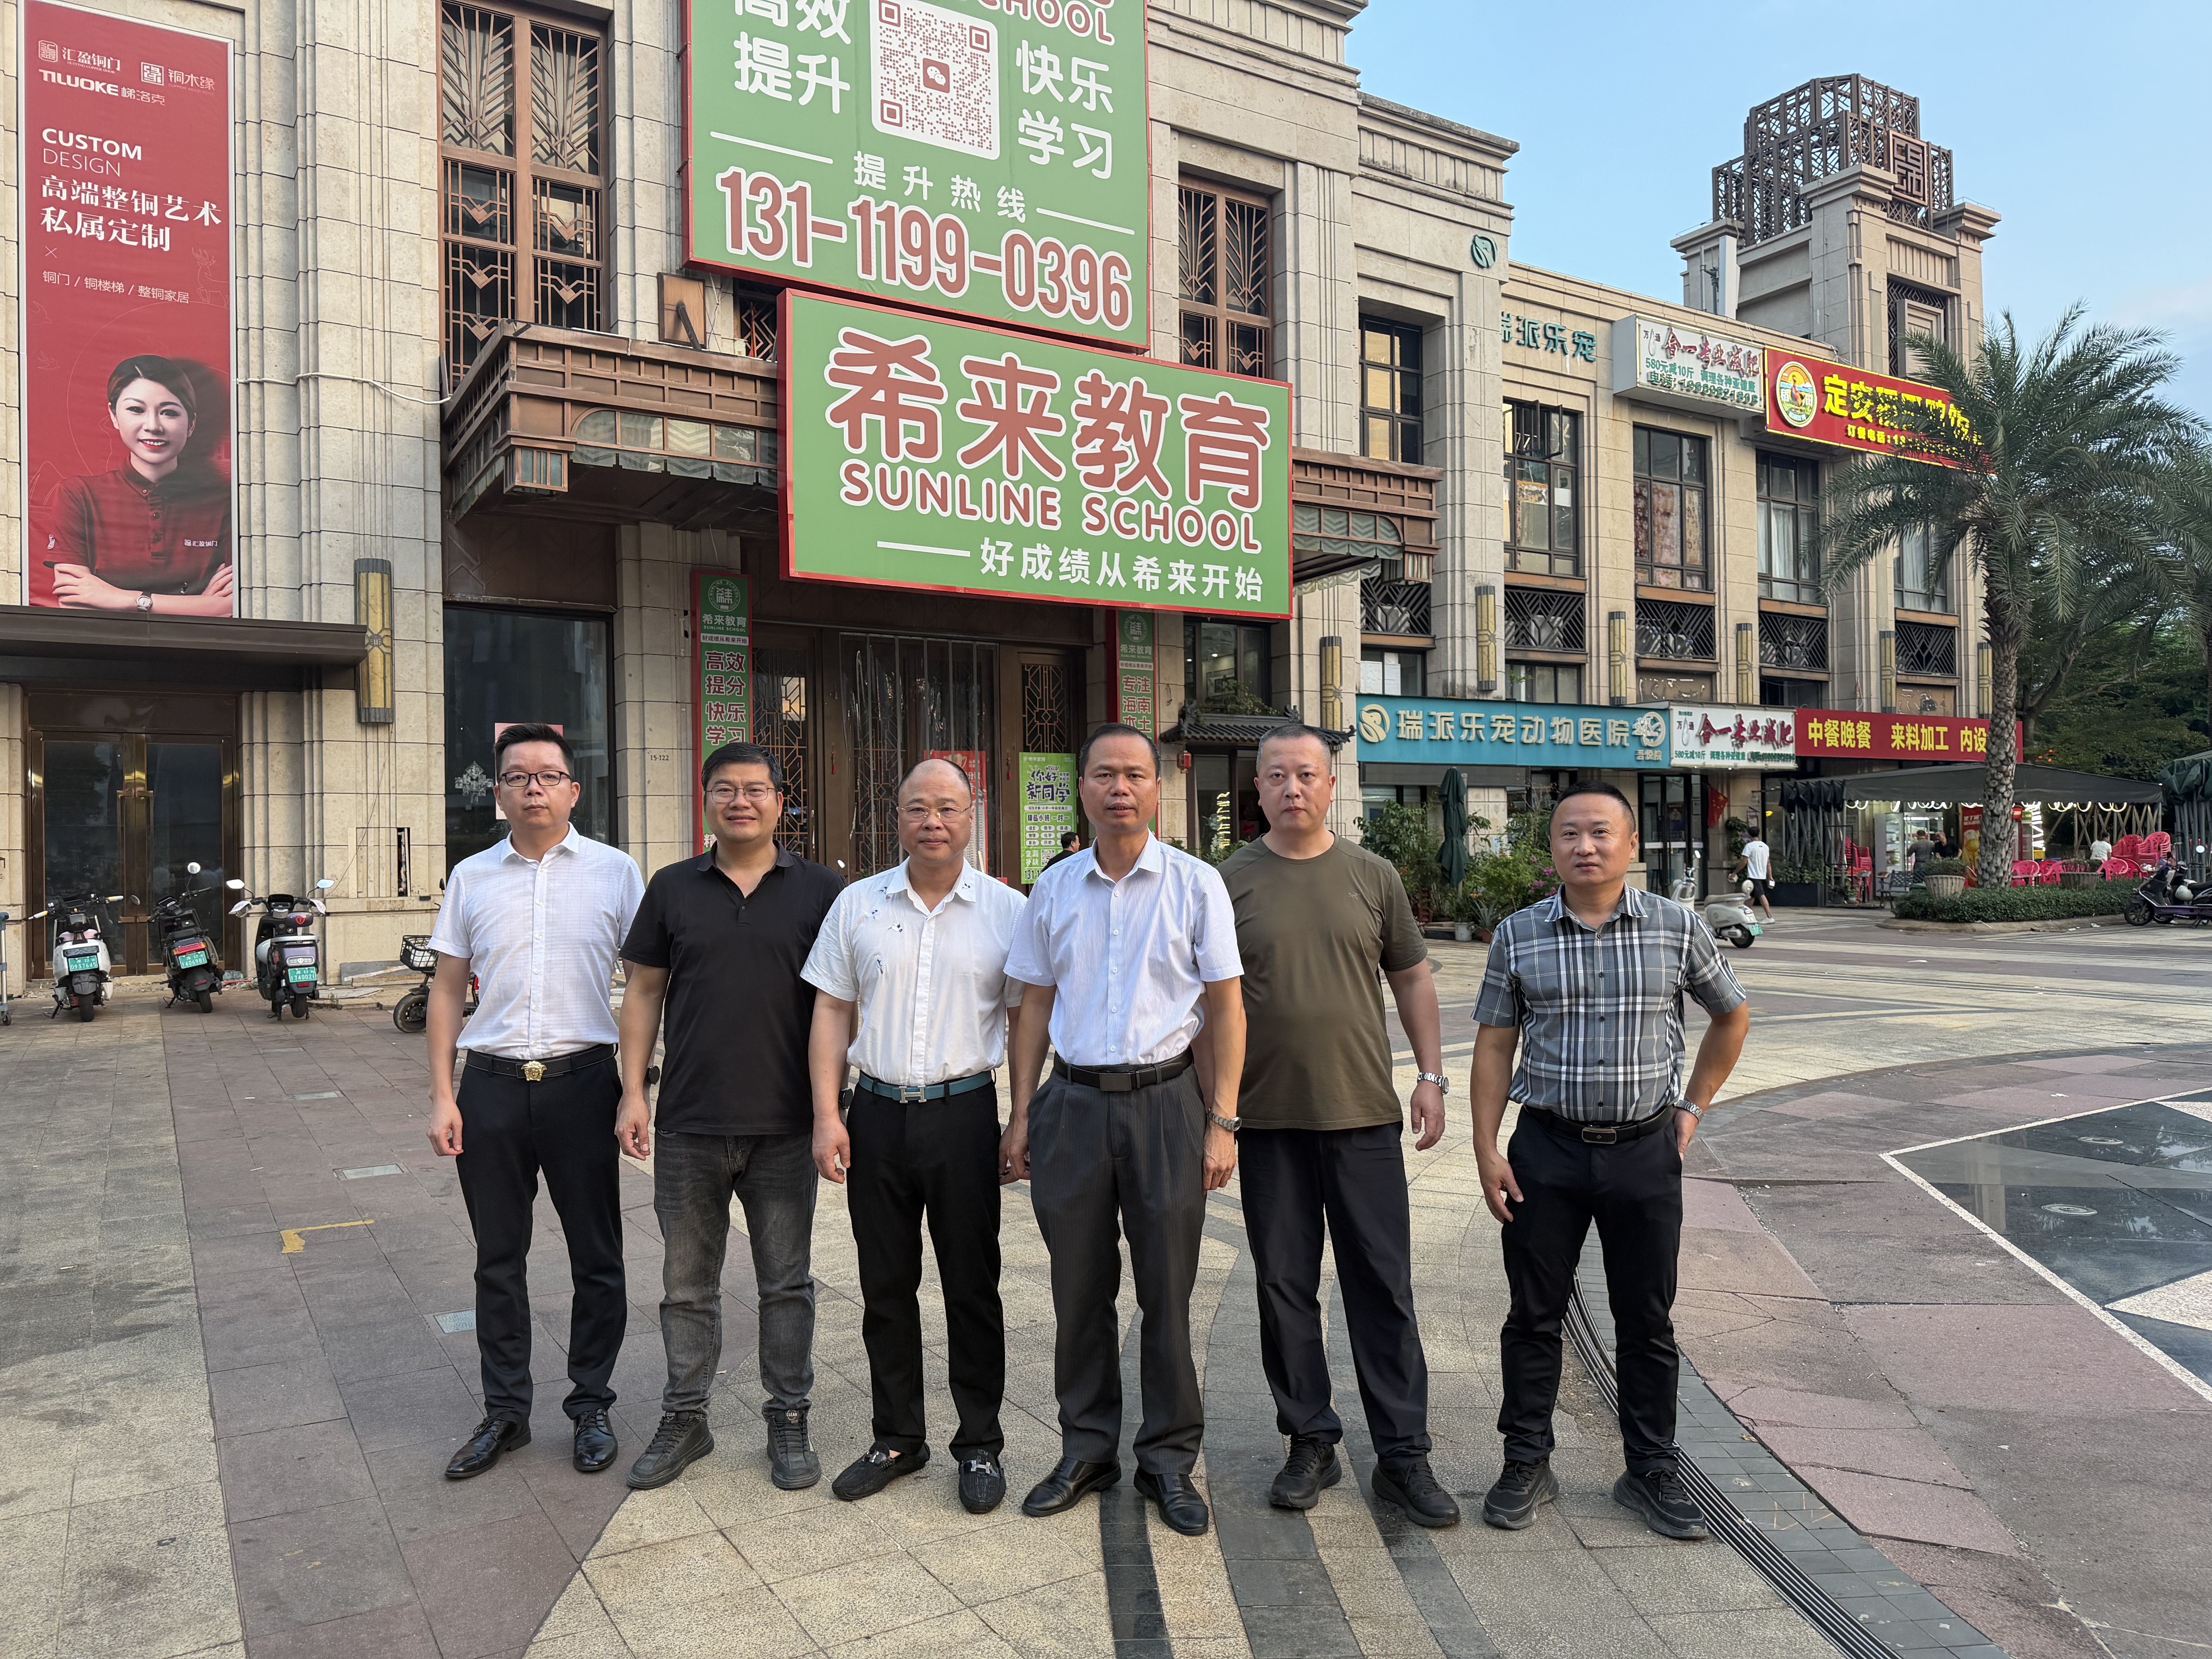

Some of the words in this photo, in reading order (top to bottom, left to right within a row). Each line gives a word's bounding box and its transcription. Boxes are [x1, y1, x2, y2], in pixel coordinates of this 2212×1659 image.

[62, 47, 120, 71] 汇盈铜门
[168, 69, 215, 91] 铜木缘
[734, 31, 851, 114] 提升
[1016, 40, 1113, 113] 快乐
[121, 87, 165, 106] 梯洛克
[42, 128, 142, 160] CUSTOM
[1018, 109, 1112, 179] 学习
[43, 148, 120, 177] DESIGN
[854, 151, 1026, 223] 提升热线
[41, 175, 222, 227] 高端整铜艺术
[40, 206, 171, 252] 私属定制
[716, 165, 1132, 330] 131-1199-0396
[43, 270, 70, 286] 铜门
[84, 277, 125, 294] 铜楼梯
[138, 285, 190, 304] 整铜家居
[824, 326, 1270, 512] 希来教育
[840, 462, 1061, 531] SUNLINE
[1082, 495, 1262, 554] SCHOOL
[980, 537, 1264, 602] 好成绩从希来开始
[702, 614, 747, 627] 希来教育
[702, 635, 747, 644] 好成绩从希来开始
[1120, 644, 1152, 655] 希来教育
[706, 651, 745, 673] 高效
[706, 675, 745, 696] 提分
[1122, 675, 1151, 693] 专注
[706, 701, 746, 722] 快乐
[1122, 696, 1151, 714] 海南
[706, 725, 745, 745] 学习
[1397, 710, 1630, 747] 瑞派乐宠动物医院
[1808, 718, 1871, 749] 中餐晚餐
[1891, 723, 1949, 751] 来料加工
[1031, 769, 1058, 782] 你好
[1026, 780, 1071, 804] 新同学
[182, 957, 205, 967] 1406981
